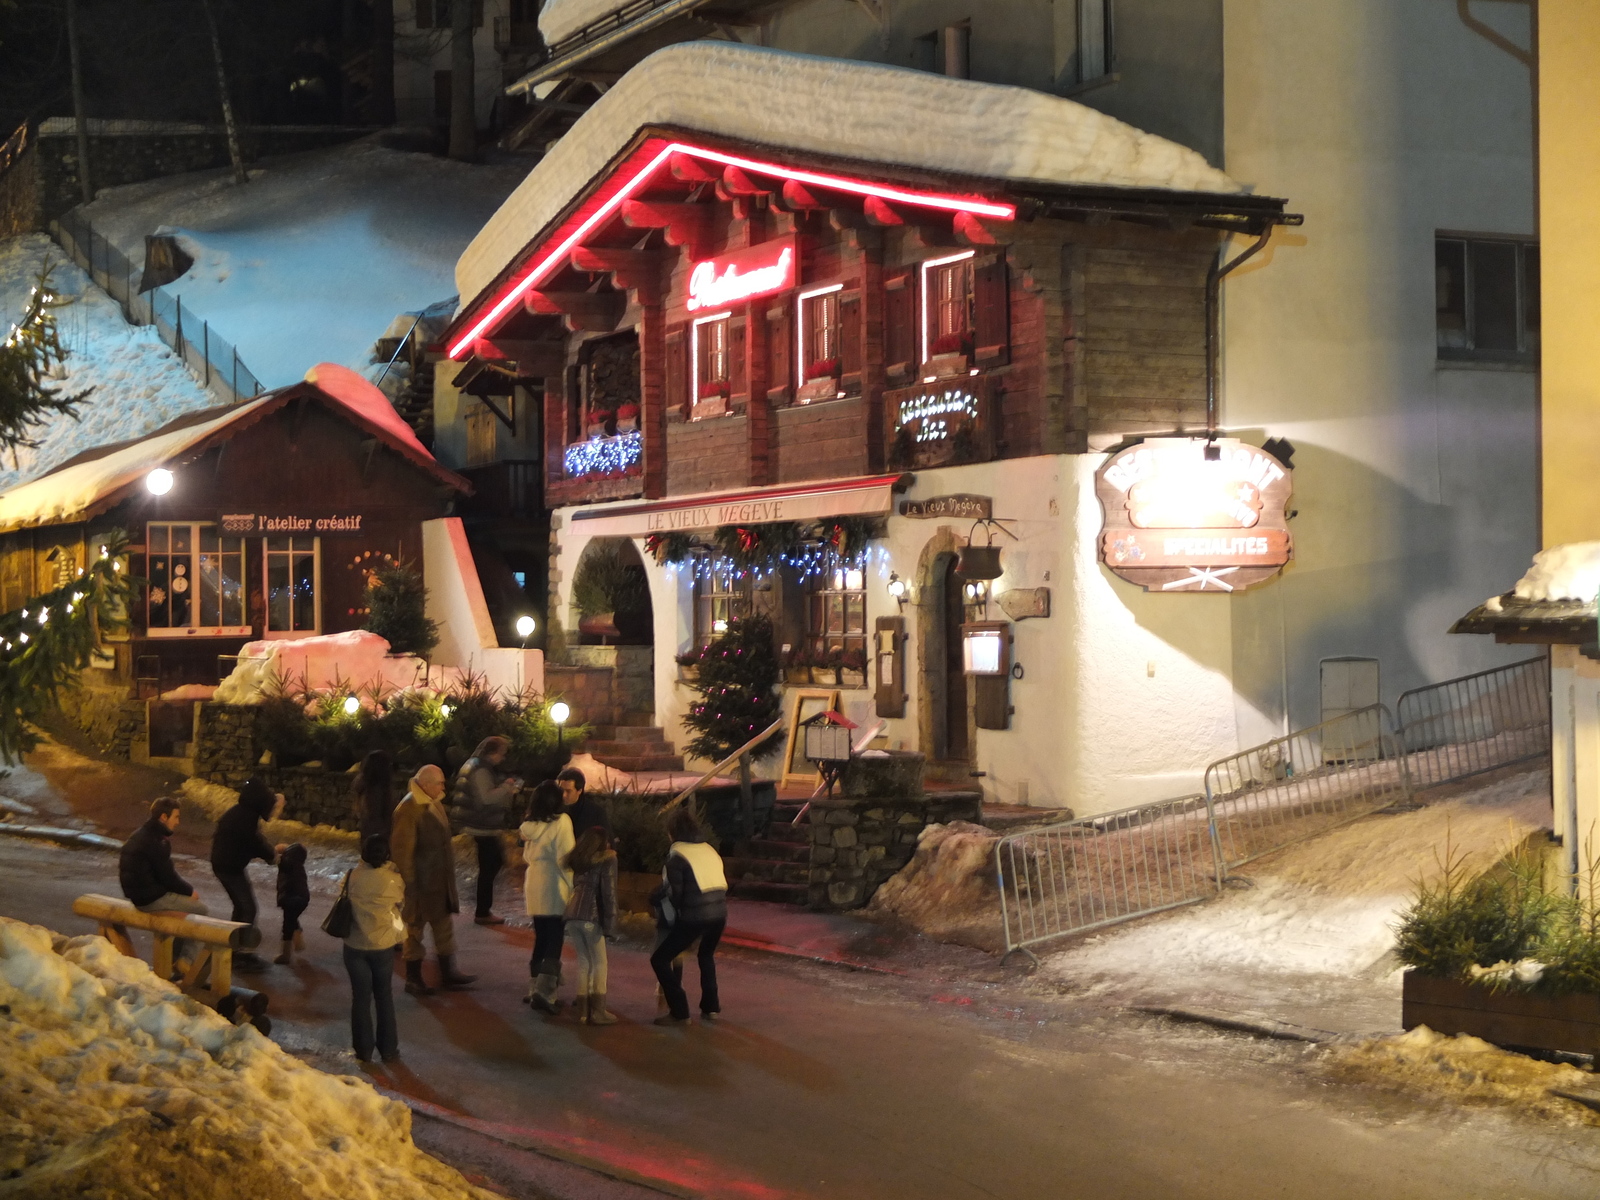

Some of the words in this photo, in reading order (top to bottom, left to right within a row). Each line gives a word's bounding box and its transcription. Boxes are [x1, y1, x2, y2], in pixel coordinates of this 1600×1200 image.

[1103, 448, 1285, 494] RESANT
[647, 513, 665, 531] LE
[668, 507, 713, 529] VIEUX
[921, 500, 946, 518] Vieux
[258, 514, 313, 531] l'atelier
[315, 513, 363, 531] créatif
